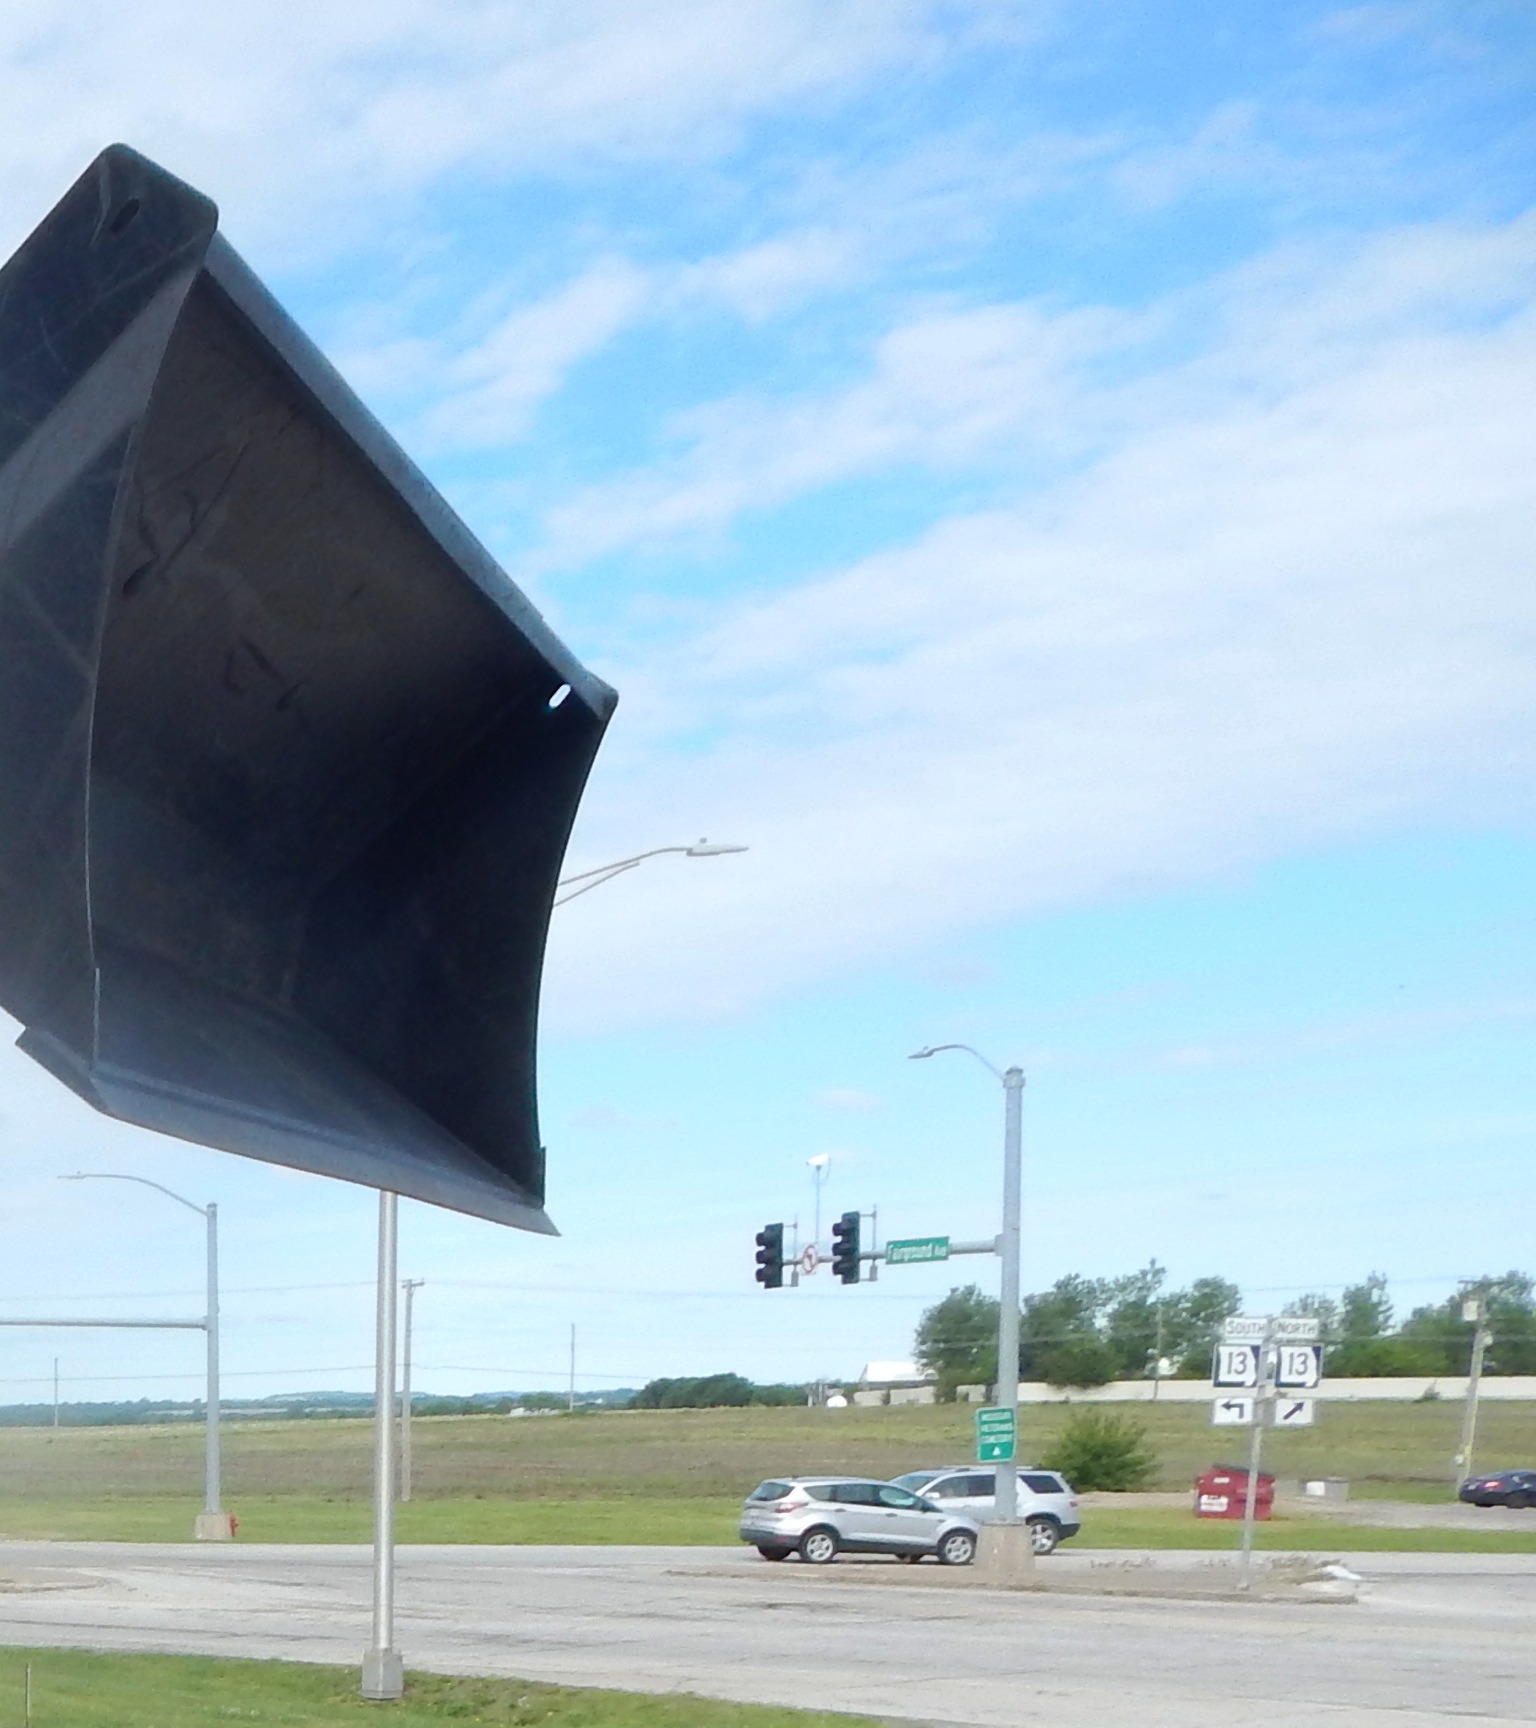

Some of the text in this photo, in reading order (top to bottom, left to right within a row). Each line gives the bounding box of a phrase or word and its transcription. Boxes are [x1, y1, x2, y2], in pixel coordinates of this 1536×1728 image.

[1278, 1320, 1316, 1335] NORTH
[1227, 1351, 1248, 1375] 13
[1288, 1351, 1309, 1376] 13
